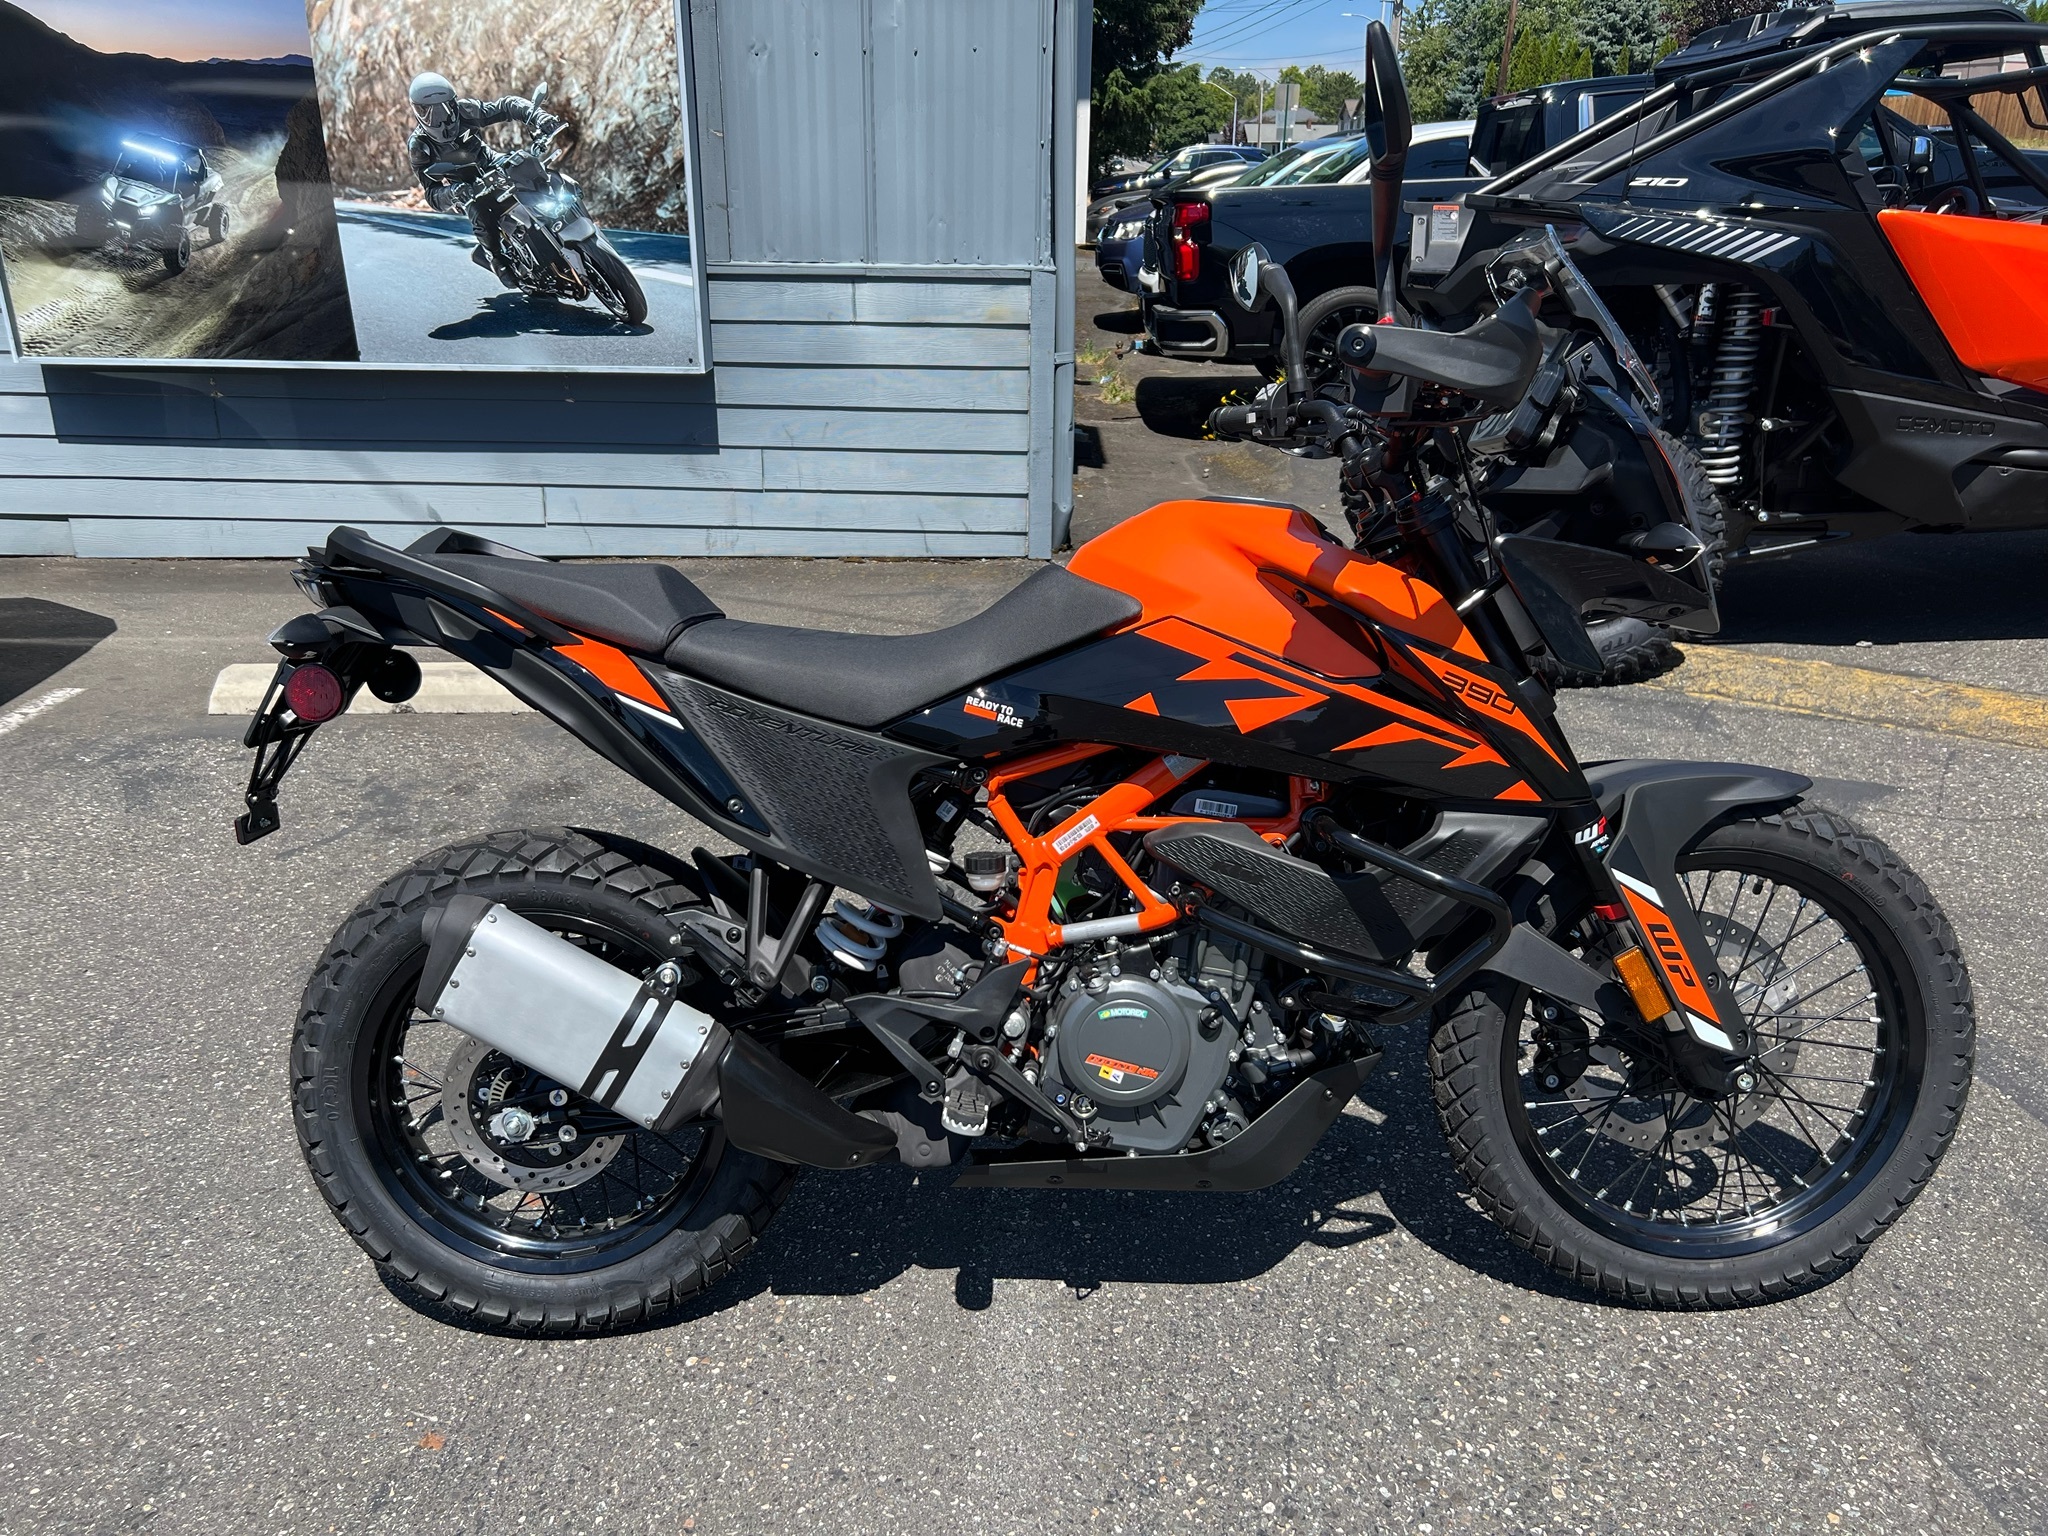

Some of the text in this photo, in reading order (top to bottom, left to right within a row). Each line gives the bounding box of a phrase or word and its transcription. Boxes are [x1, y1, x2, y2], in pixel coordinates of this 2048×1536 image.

[1627, 176, 1689, 188] Z10
[1895, 416, 1996, 438] CFMOTO
[1441, 670, 1516, 715] 390
[965, 695, 1014, 716] READY TO
[706, 699, 879, 757] ADVENTURE
[996, 713, 1024, 728] RACE
[1574, 816, 1607, 845] WP
[1645, 923, 1697, 988] WP
[1110, 1007, 1148, 1019] MOTOREX
